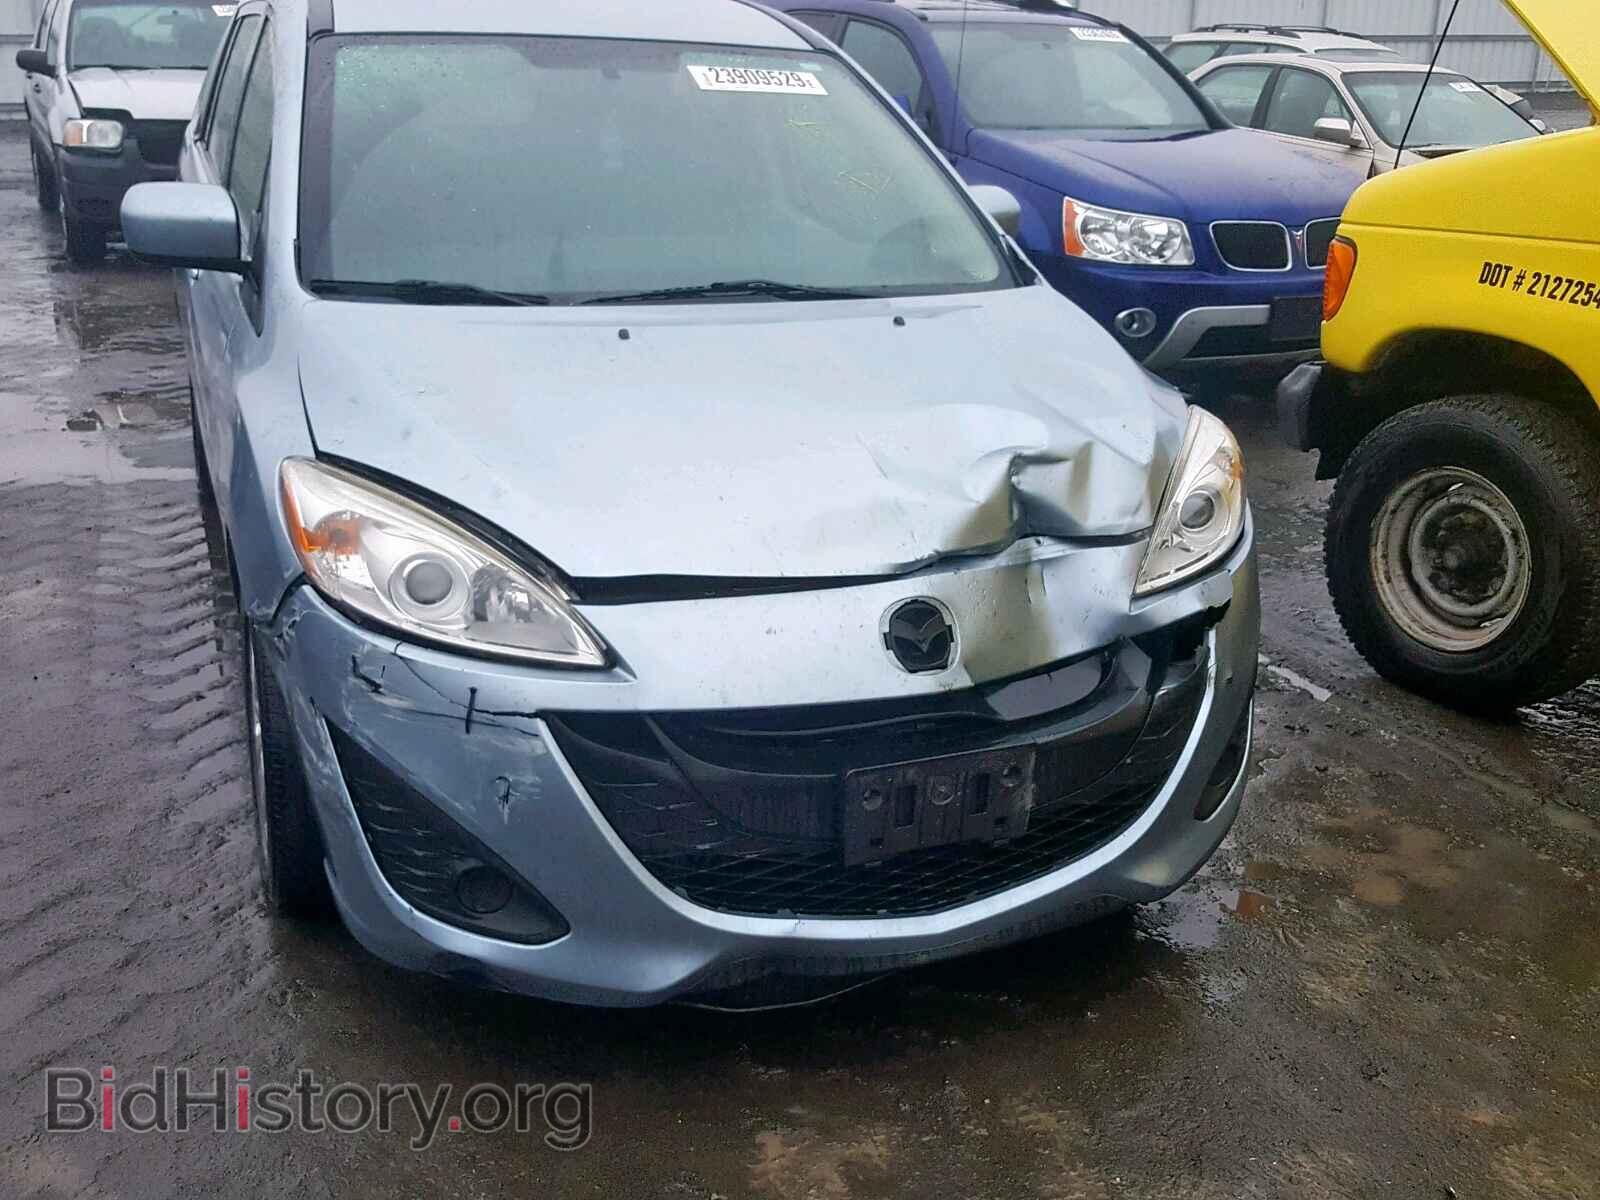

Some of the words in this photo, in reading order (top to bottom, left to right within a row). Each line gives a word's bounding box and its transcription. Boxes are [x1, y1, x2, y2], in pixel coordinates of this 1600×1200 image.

[708, 67, 806, 88] 23909529
[1478, 261, 1513, 289] DOT
[1511, 268, 1527, 292] #
